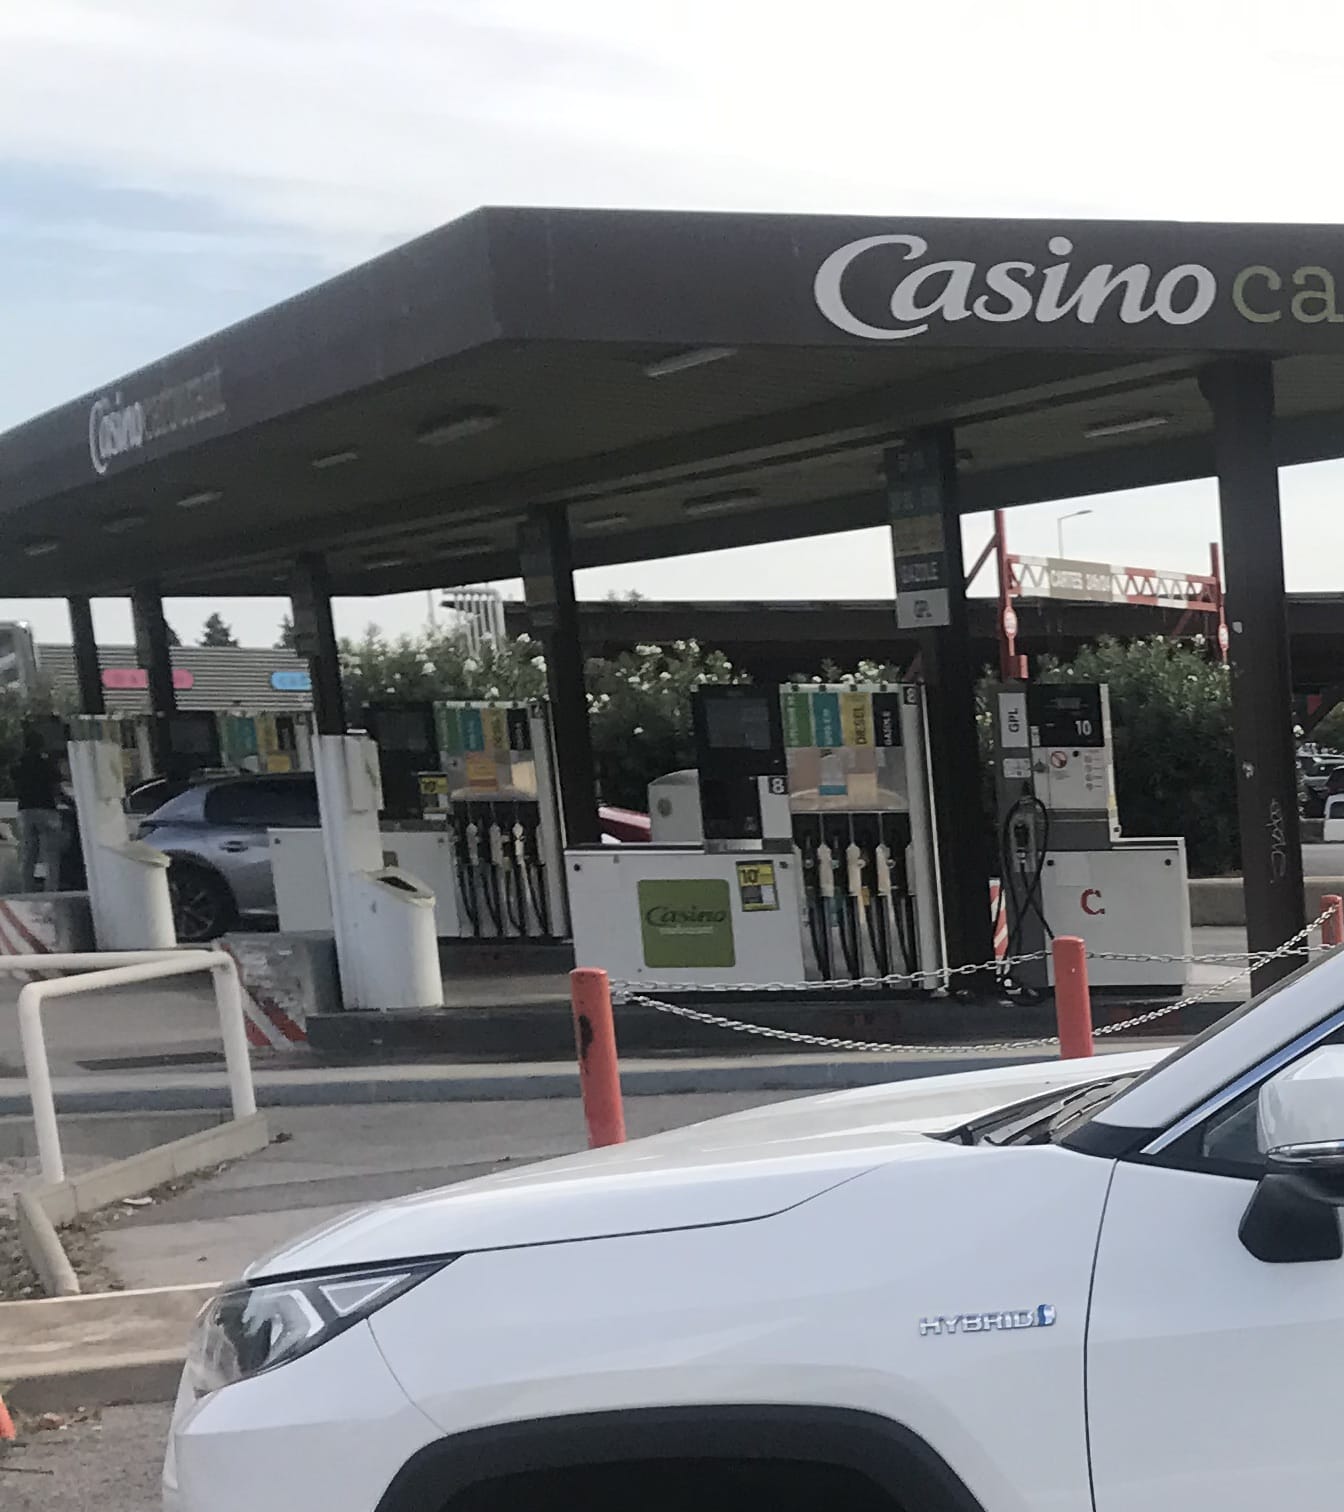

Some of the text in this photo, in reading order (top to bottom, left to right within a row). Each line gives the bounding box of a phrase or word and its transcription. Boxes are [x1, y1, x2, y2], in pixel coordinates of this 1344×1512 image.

[813, 233, 1218, 340] Casino
[1008, 707, 1020, 733] GPL
[1074, 720, 1093, 736] 10
[771, 777, 785, 794] 8
[647, 905, 728, 929] Casino
[918, 1310, 1034, 1336] HYBRID
